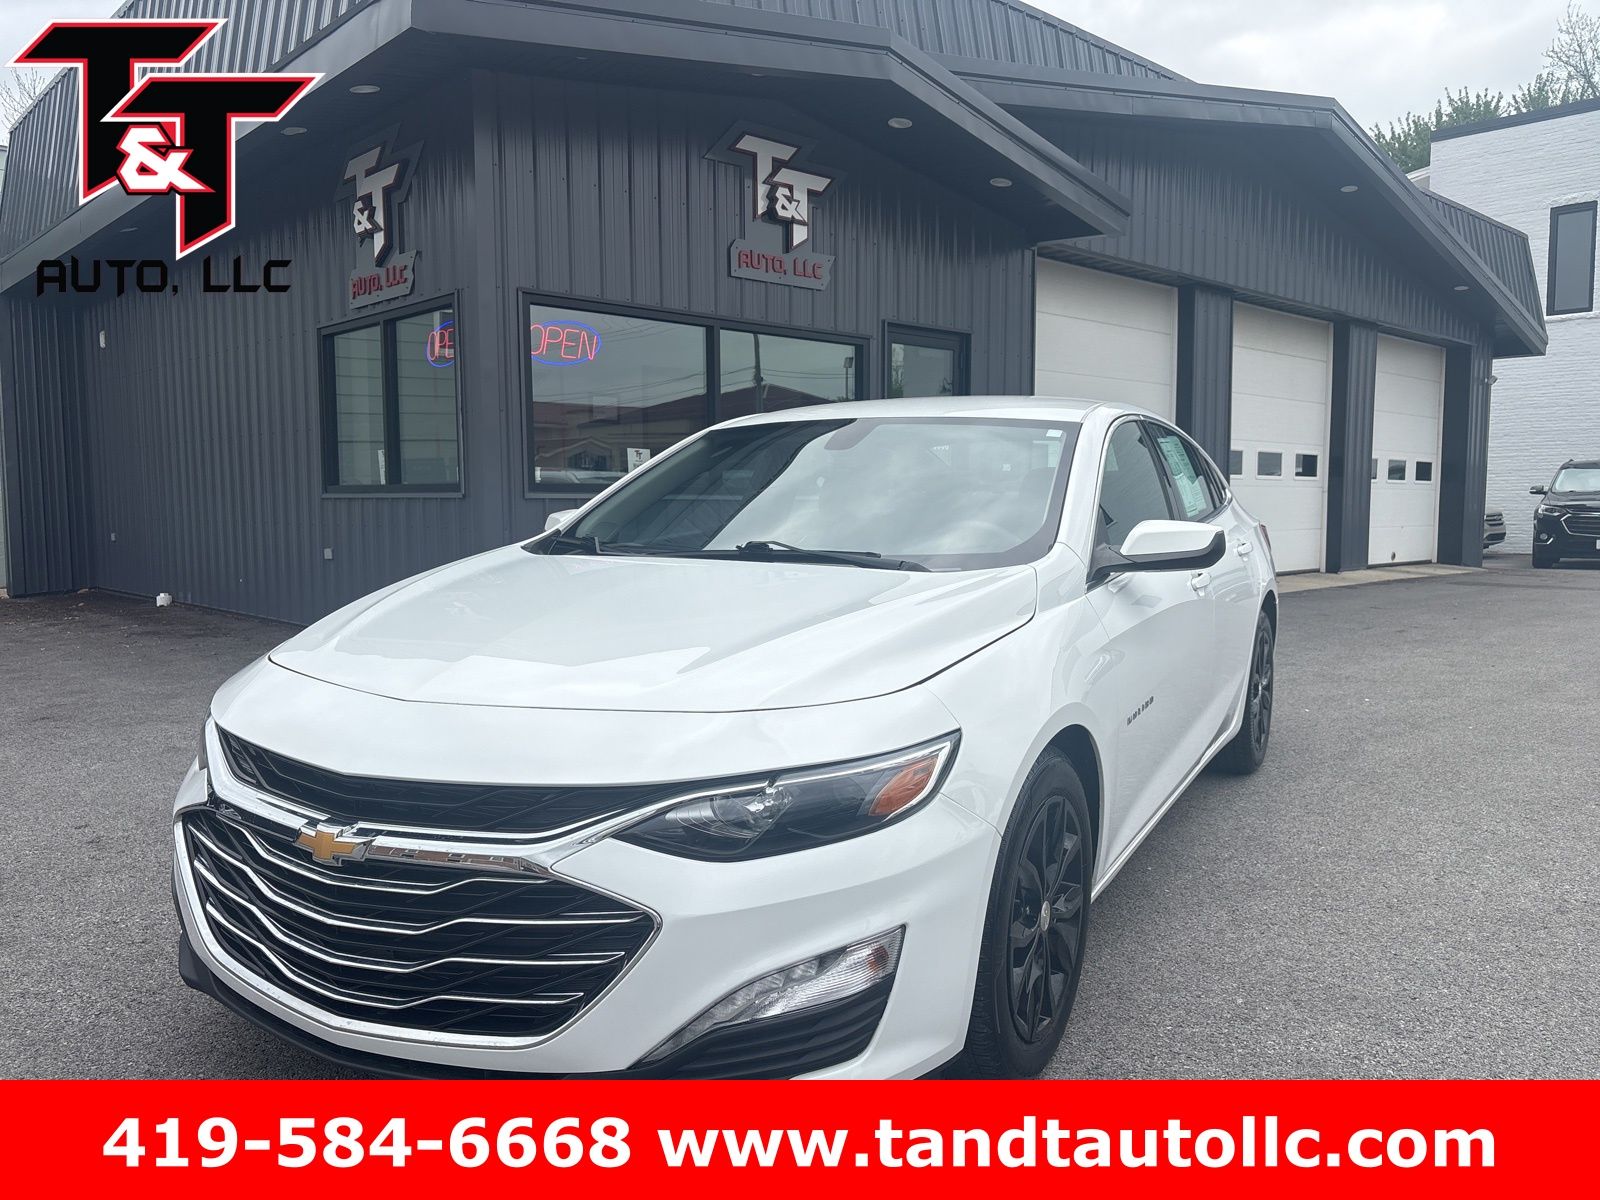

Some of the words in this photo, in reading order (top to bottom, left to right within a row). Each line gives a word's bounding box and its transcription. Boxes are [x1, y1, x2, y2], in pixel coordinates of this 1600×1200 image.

[734, 133, 832, 248] T&T
[737, 250, 786, 275] AUTO,
[793, 257, 823, 279] LLC
[351, 274, 383, 299] AUTO,
[385, 265, 407, 287] LLC
[427, 328, 455, 361] OPE
[530, 323, 597, 360] OPEN
